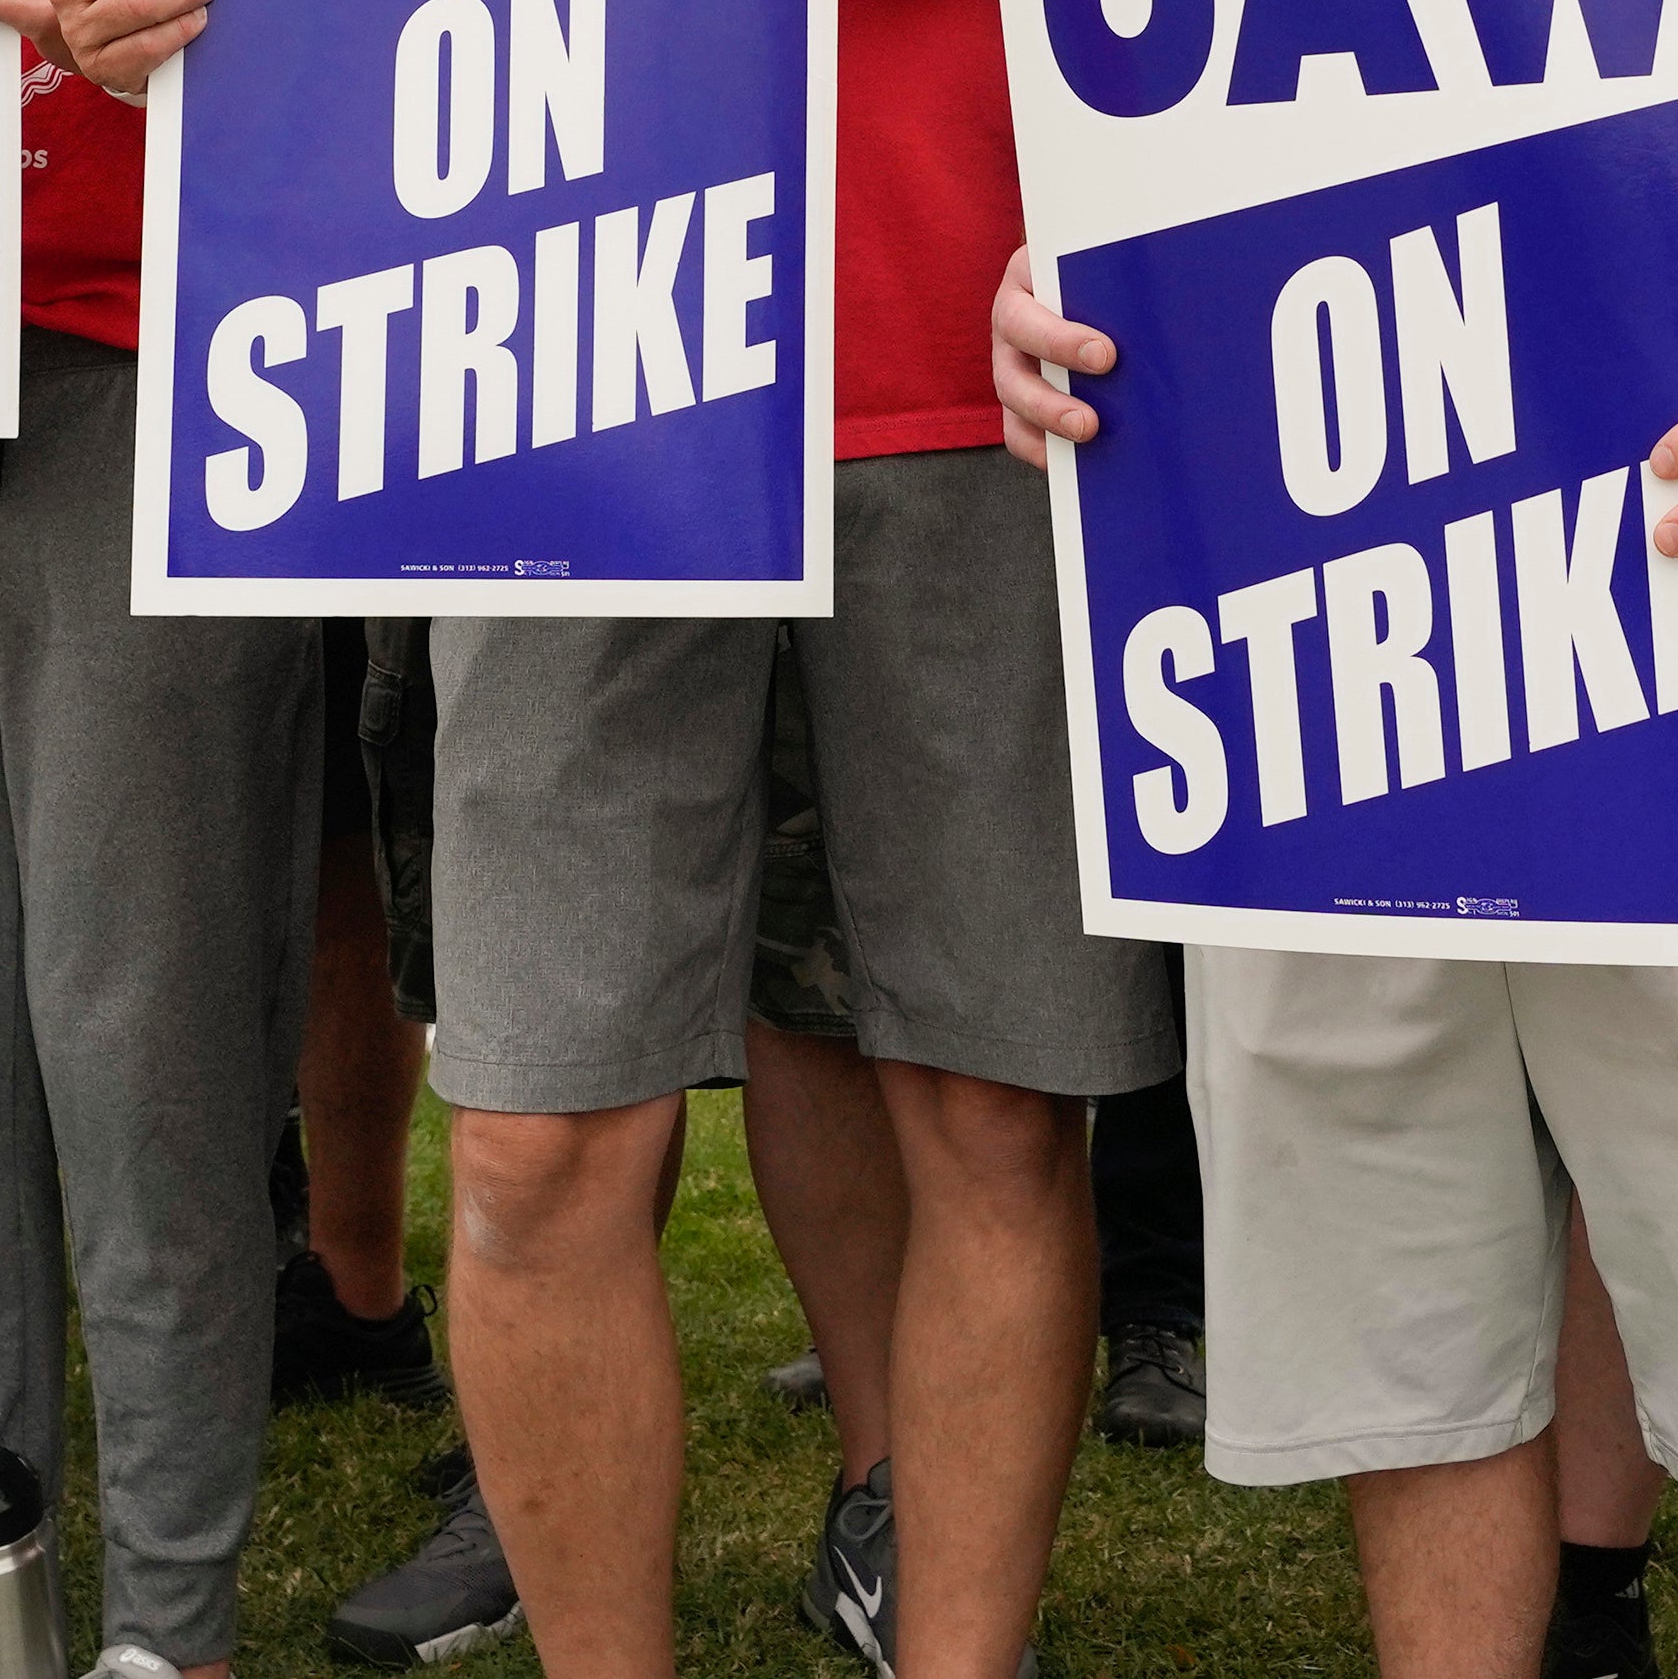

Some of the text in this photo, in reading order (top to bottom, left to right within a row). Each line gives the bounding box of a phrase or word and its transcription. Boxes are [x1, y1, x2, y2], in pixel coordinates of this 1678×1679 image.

[204, 170, 777, 532] STRIKE
[1270, 200, 1517, 518] ON
[400, 564, 431, 572] SAWICKI
[432, 564, 438, 572] &
[439, 564, 455, 572] SON
[1333, 898, 1366, 907] SAWICKI
[1375, 899, 1392, 908] SON
[1395, 900, 1414, 909] (313)
